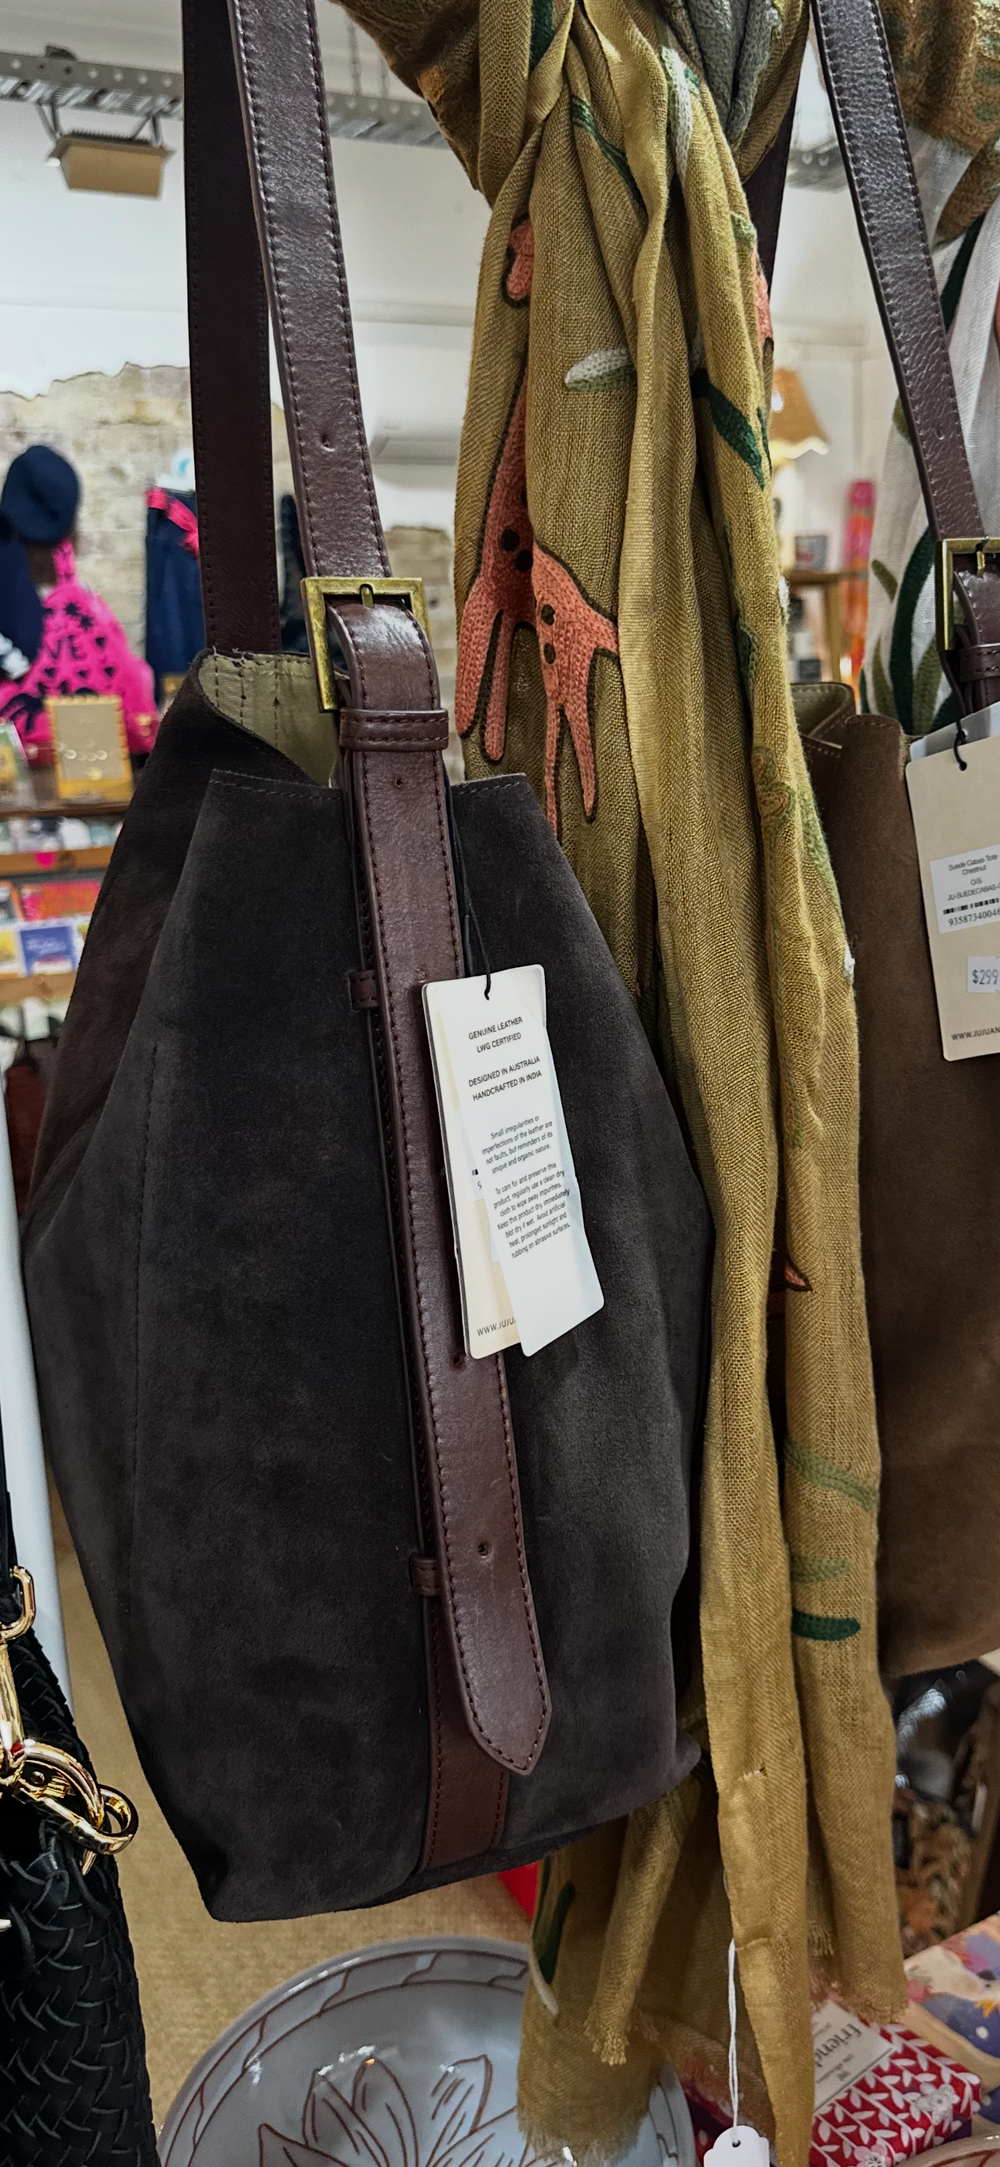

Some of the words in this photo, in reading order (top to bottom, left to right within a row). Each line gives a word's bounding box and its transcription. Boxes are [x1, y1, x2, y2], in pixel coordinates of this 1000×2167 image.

[948, 862, 966, 871] Suede
[967, 858, 985, 866] Cabas
[962, 865, 986, 875] Chestnut
[972, 969, 998, 985] $299
[469, 1025, 496, 1040] GENUINE
[497, 1017, 523, 1030] LEATHER
[477, 1043, 491, 1053] LWG
[492, 1032, 521, 1048] CERTIFIED
[469, 1070, 500, 1087] DESIGNED
[509, 1056, 540, 1073] AUSTRALIA
[473, 1079, 518, 1101] HANDCRAFTED
[526, 1070, 542, 1081] INDIA
[482, 1137, 513, 1155] imperfections
[528, 1124, 544, 1135] leather
[491, 1128, 504, 1139] Small
[505, 1118, 534, 1132] irregularities
[518, 1136, 540, 1150] reminders
[492, 1163, 507, 1174] unique
[508, 1157, 517, 1166] and
[518, 1150, 534, 1162] organic
[535, 1144, 551, 1154] nature.
[494, 1195, 511, 1210] product,
[512, 1186, 530, 1199] regularly
[543, 1174, 555, 1184] clean
[502, 1184, 511, 1192] care
[519, 1175, 527, 1184] and
[528, 1167, 547, 1180] preserve
[498, 1221, 509, 1230] Keep
[518, 1206, 534, 1220] product
[544, 1188, 570, 1205] immediately
[500, 1207, 511, 1217] cloth
[528, 1194, 538, 1203] away
[539, 1183, 562, 1196] impurities.
[505, 1230, 514, 1238] blot
[536, 1210, 548, 1220] Avoid
[549, 1201, 565, 1214] artificial
[521, 1226, 542, 1242] prolonged
[542, 1216, 558, 1229] sunlight
[512, 1246, 528, 1258] rubbing
[535, 1232, 552, 1246] abrasive
[552, 1222, 570, 1235] surfaces.
[477, 1317, 516, 1336] WWW.JUJU
